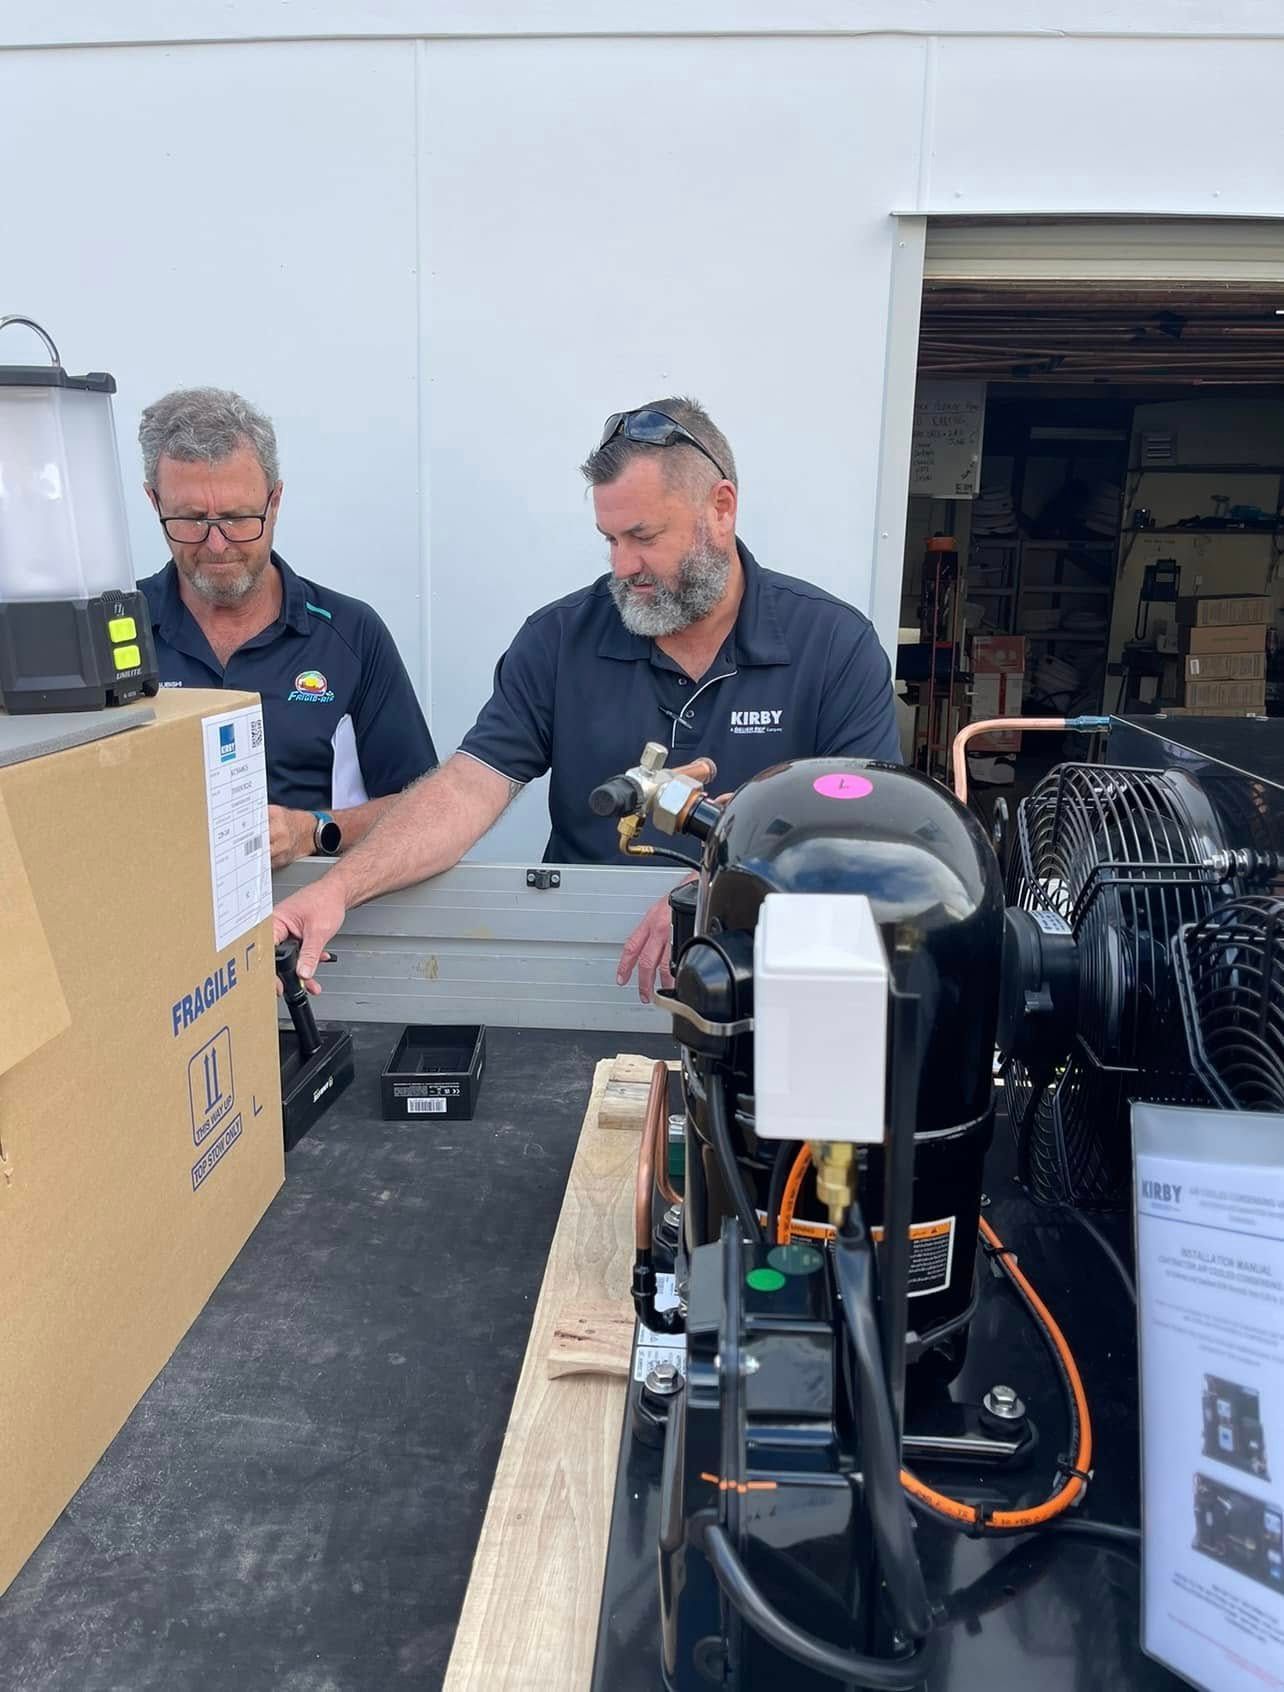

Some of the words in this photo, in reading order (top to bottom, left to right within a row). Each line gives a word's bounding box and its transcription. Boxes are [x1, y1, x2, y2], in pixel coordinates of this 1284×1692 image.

[731, 710, 783, 725] KIRBY
[171, 958, 238, 1038] FRAGILE
[196, 1119, 211, 1140] THIS
[210, 1104, 224, 1125] WAY
[224, 1095, 232, 1110] UP
[194, 1160, 207, 1183] TOP
[207, 1137, 225, 1167] STOW
[225, 1121, 240, 1146] ONLY
[1141, 1179, 1183, 1203] KIRBY
[1181, 1247, 1234, 1268] INSTALLATION
[1236, 1259, 1272, 1277] MANUAL
